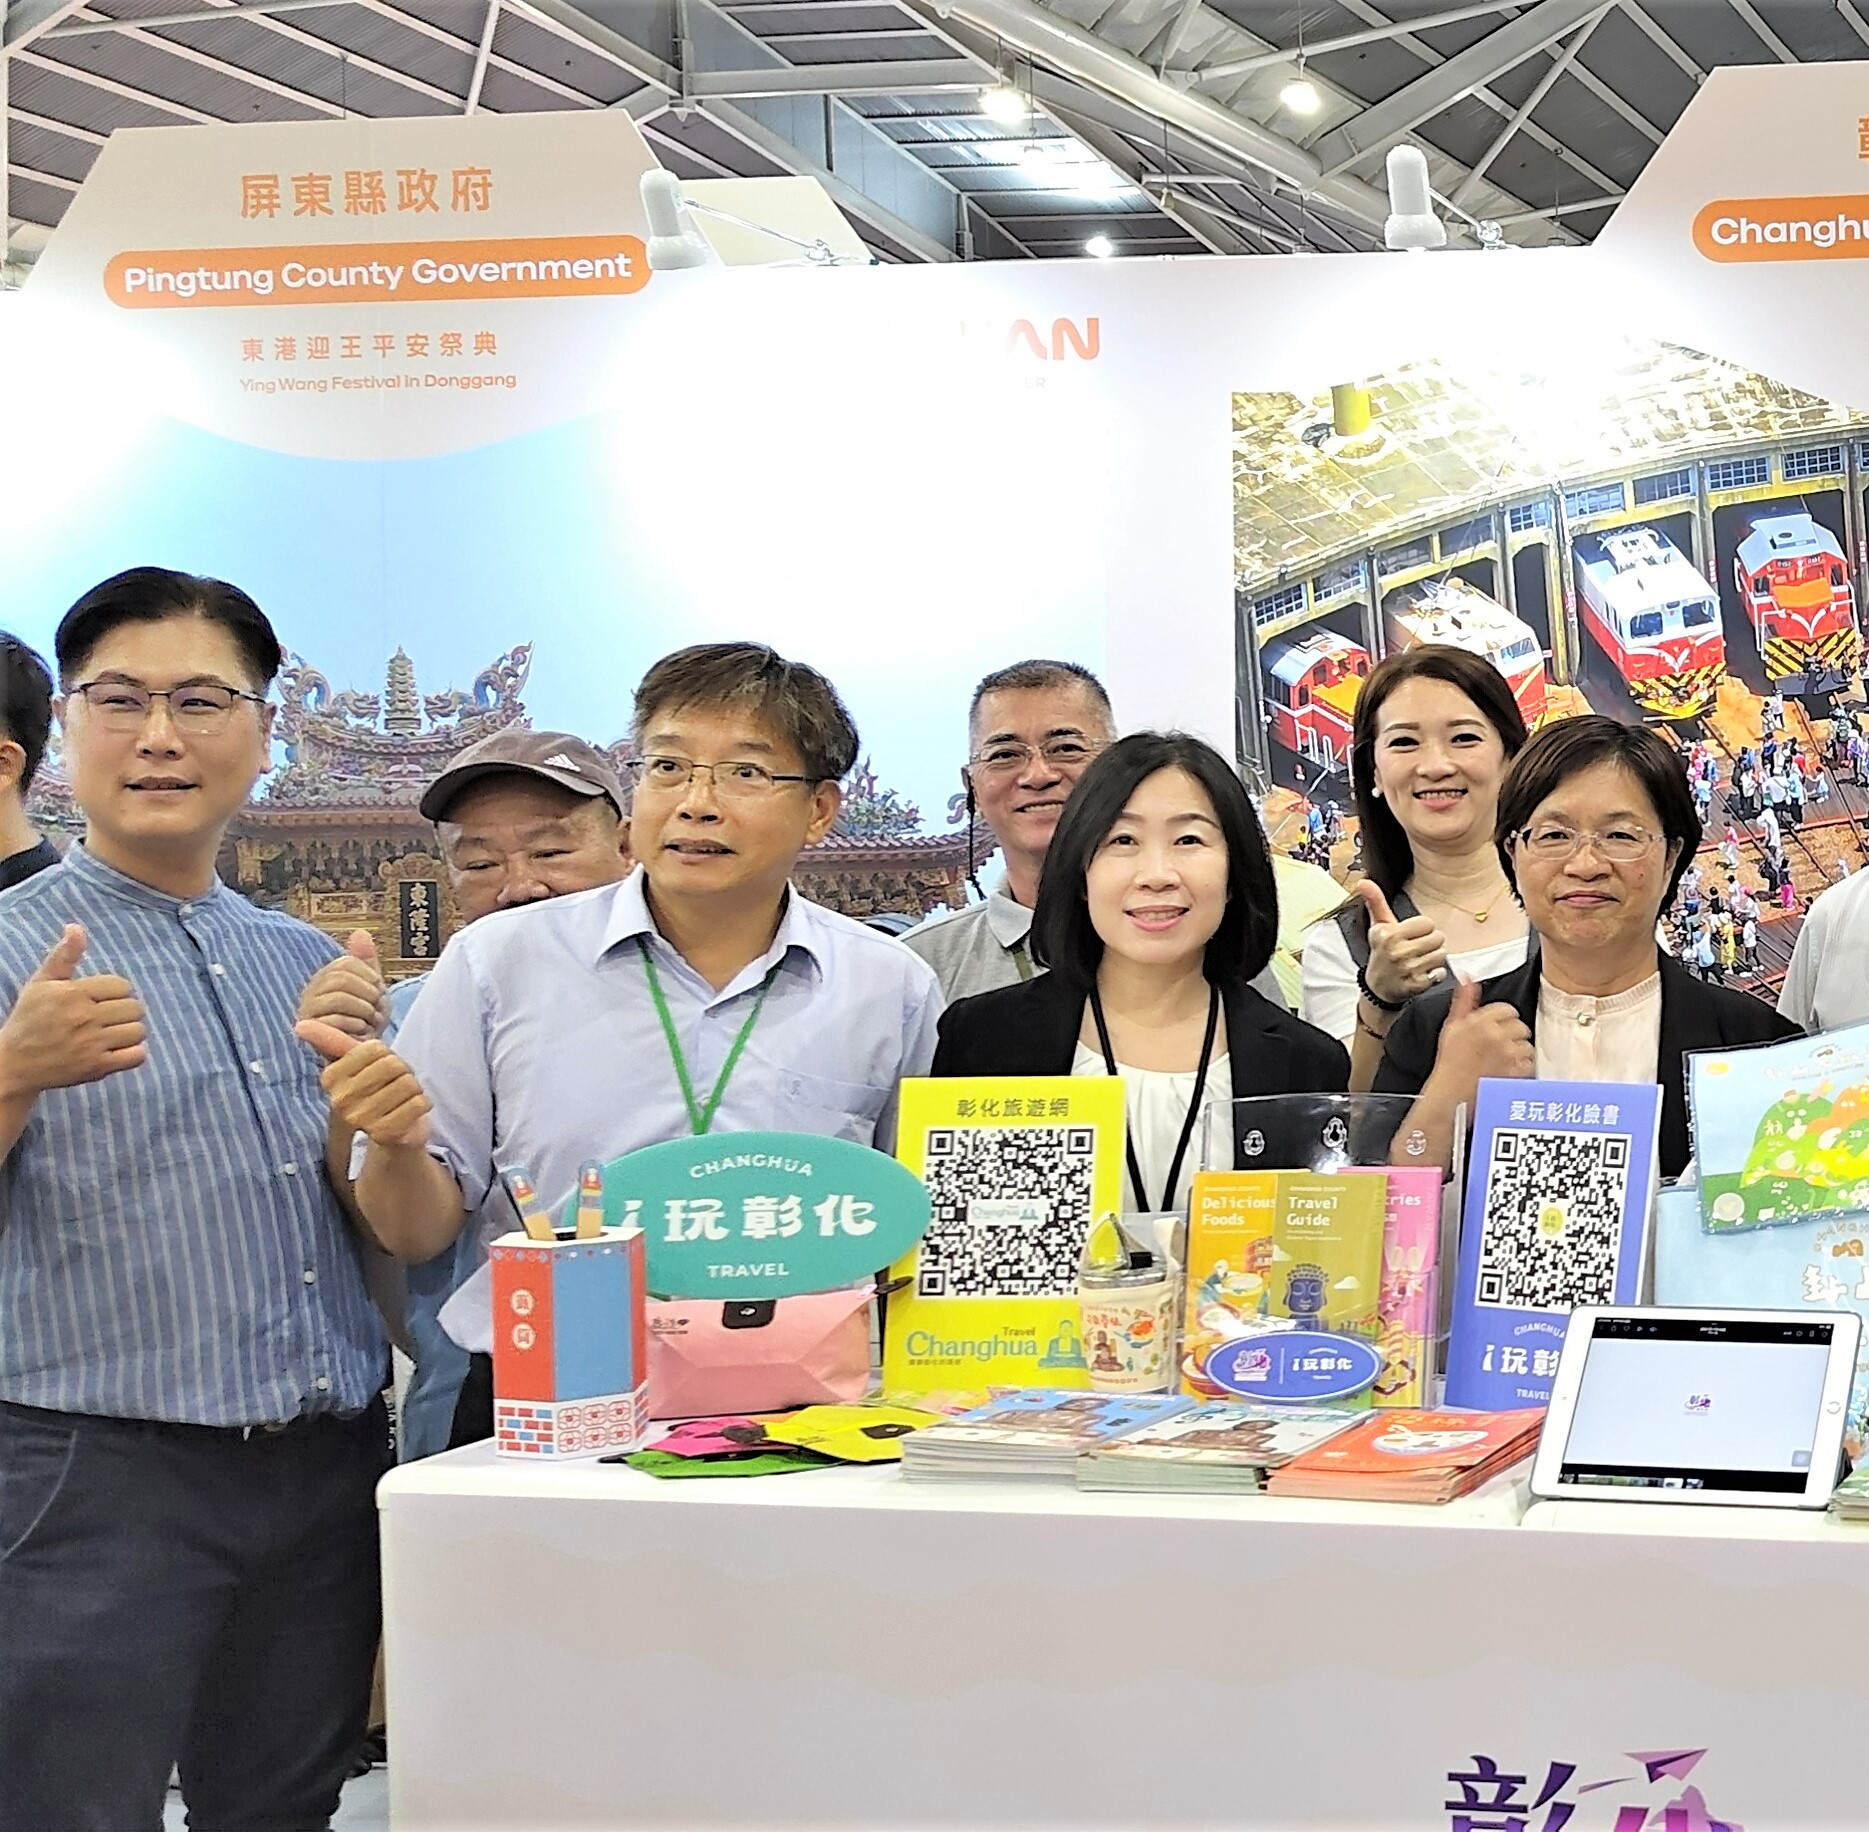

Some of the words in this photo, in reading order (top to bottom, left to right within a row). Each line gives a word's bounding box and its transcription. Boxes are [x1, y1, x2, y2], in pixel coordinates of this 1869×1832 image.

[240, 165, 495, 219] 屏東縣政府
[123, 263, 275, 297] Pingtung
[281, 259, 404, 292] County
[412, 252, 633, 286] Government
[241, 331, 498, 362] 東港迎王平安祭典
[240, 376, 276, 395] Ying
[278, 375, 328, 394] Wang
[331, 372, 401, 390] Festival
[424, 370, 517, 394] Donggang
[408, 882, 430, 956] 東隆宮
[956, 1098, 1070, 1118] 彰化旅遊網
[1510, 1101, 1620, 1125] 愛玩彰化臉書
[690, 1153, 814, 1179] CHANGHUA
[1202, 1196, 1277, 1210] Delicious
[1288, 1196, 1337, 1209] Travel
[1201, 1213, 1245, 1226] Foods
[1286, 1213, 1331, 1226] Guide
[707, 1264, 789, 1279] TRAVEL
[1003, 1326, 1036, 1337] Travel
[1513, 1322, 1566, 1338] CHANGHUA
[906, 1330, 1038, 1361] Changhua
[1517, 1388, 1550, 1402] TRAVEL
